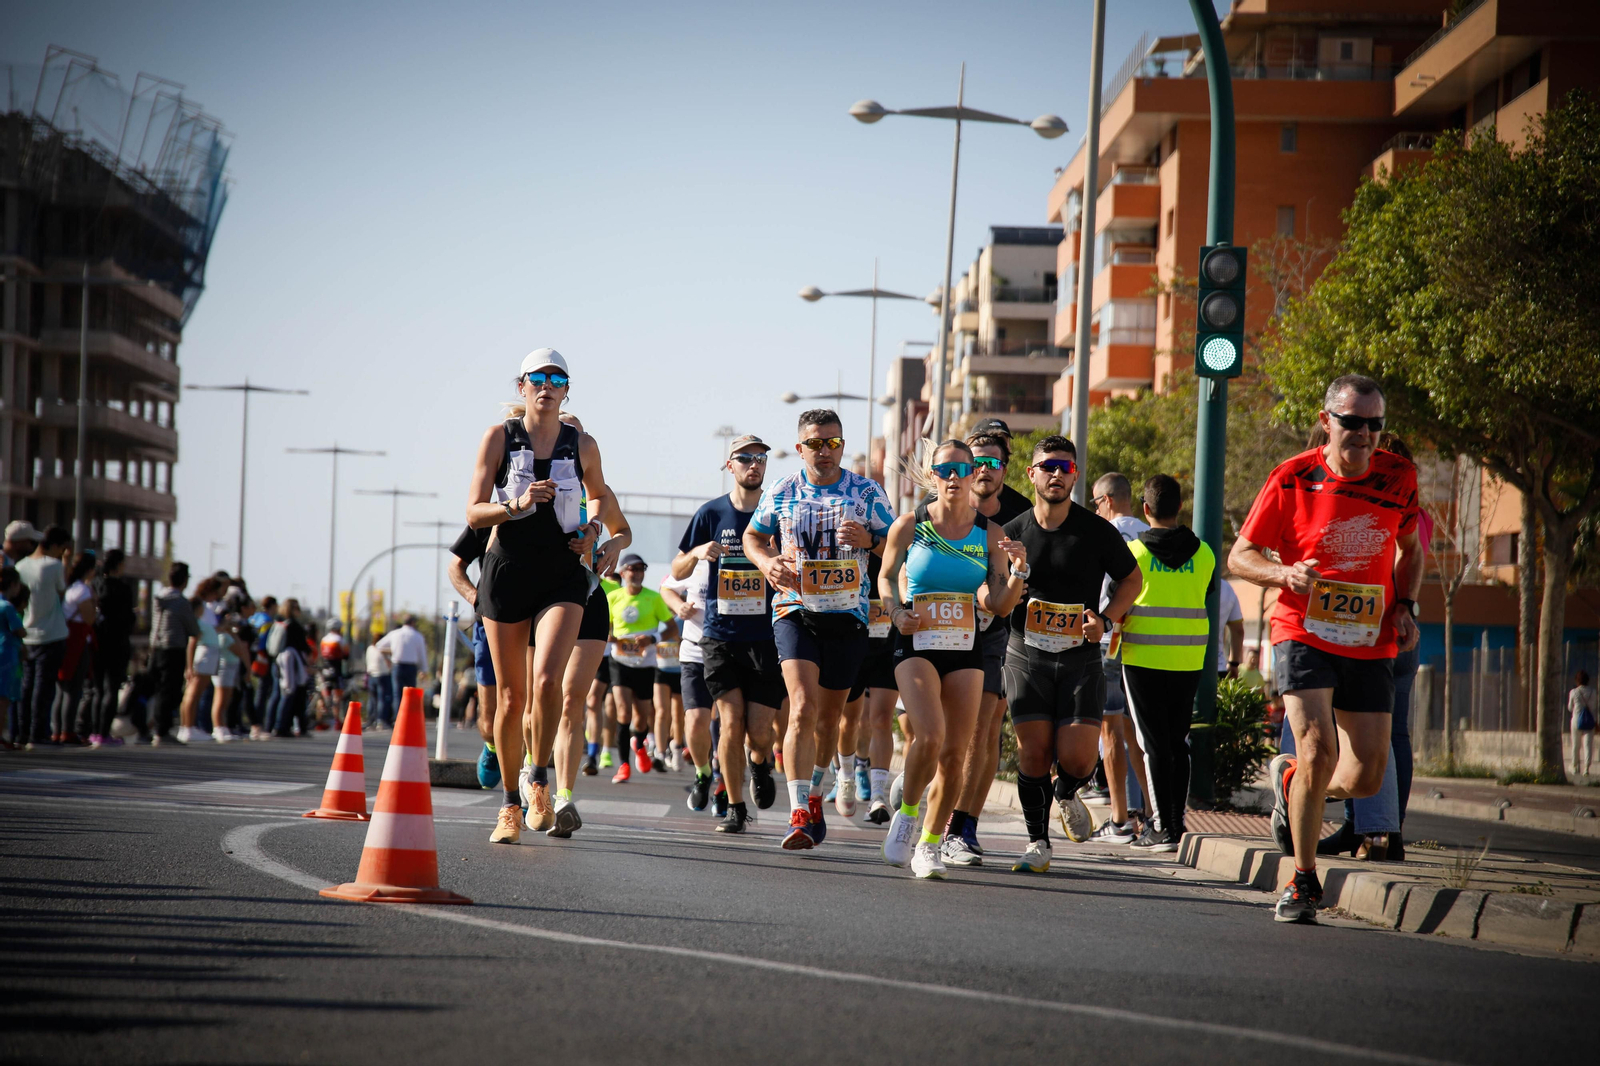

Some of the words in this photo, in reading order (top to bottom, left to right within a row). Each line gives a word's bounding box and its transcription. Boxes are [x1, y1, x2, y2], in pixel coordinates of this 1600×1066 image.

[1322, 530, 1385, 545] carrera
[963, 544, 984, 553] NEXA
[723, 578, 761, 591] 1648
[809, 568, 856, 585] 1738
[927, 602, 964, 620] 166
[1319, 592, 1376, 616] 1201
[1033, 609, 1079, 628] 1737
